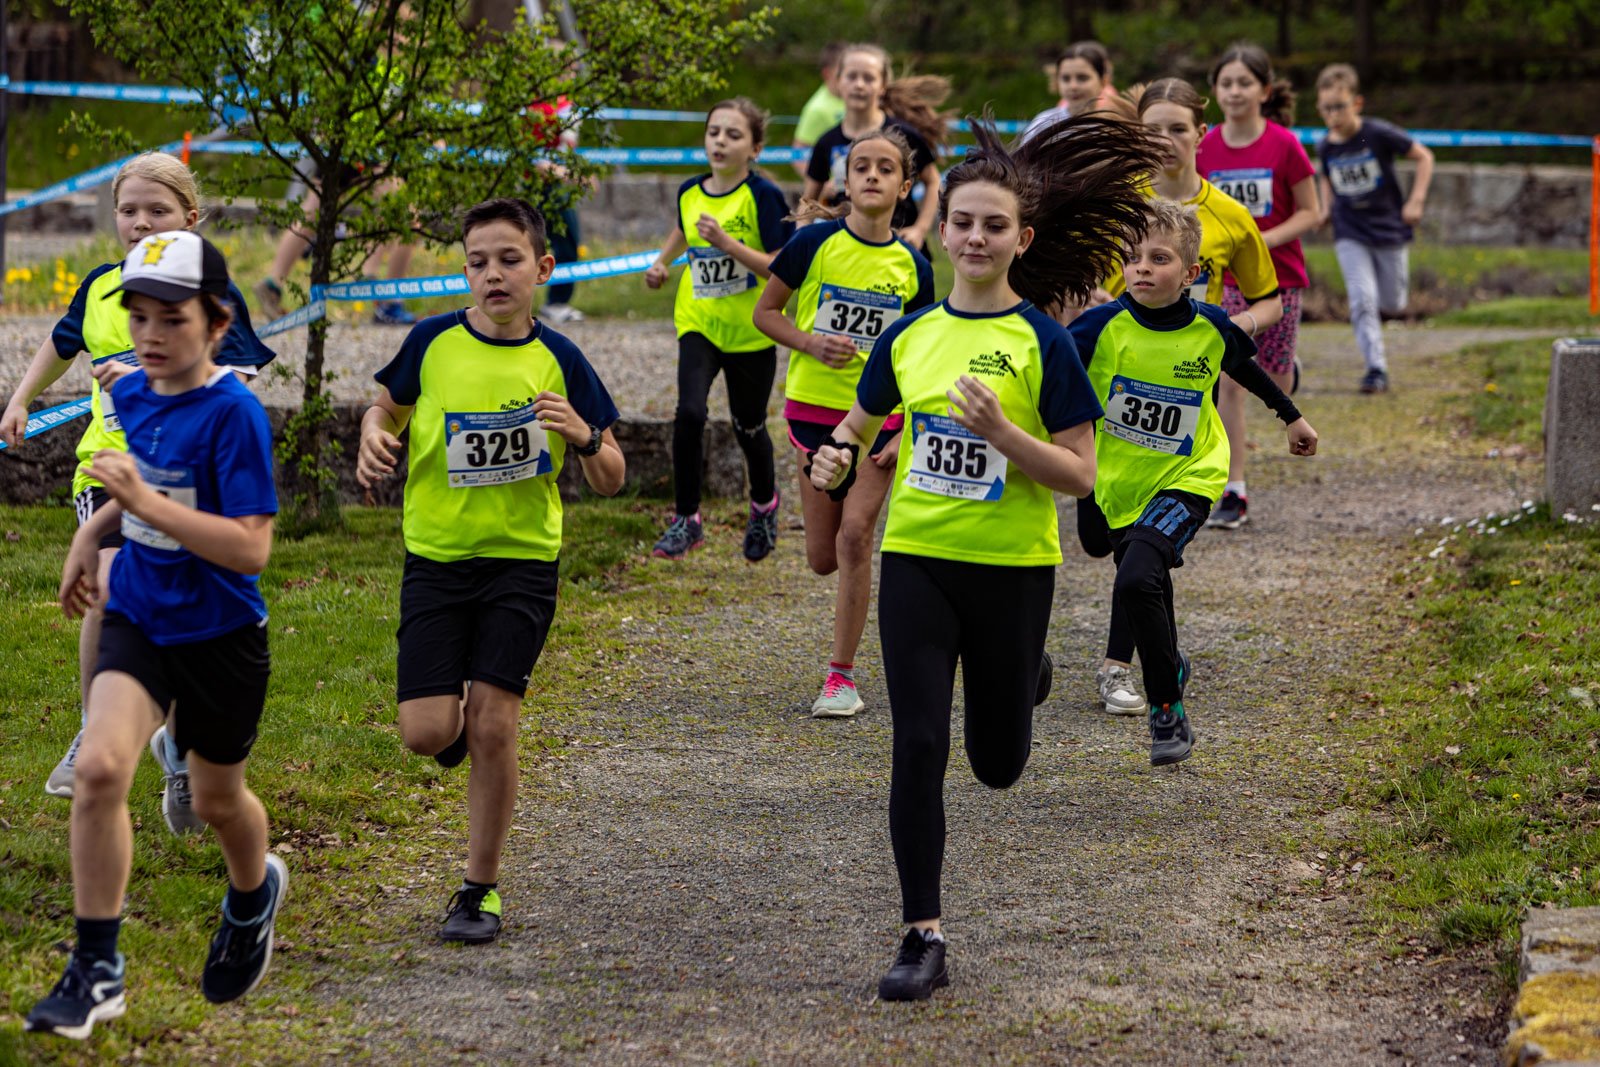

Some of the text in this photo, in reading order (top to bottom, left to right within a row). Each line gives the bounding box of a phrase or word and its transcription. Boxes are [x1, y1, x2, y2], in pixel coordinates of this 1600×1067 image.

[698, 257, 739, 284] 322
[830, 302, 884, 337] 325
[1121, 396, 1182, 436] 330
[466, 428, 530, 467] 329
[927, 436, 987, 479] 335
